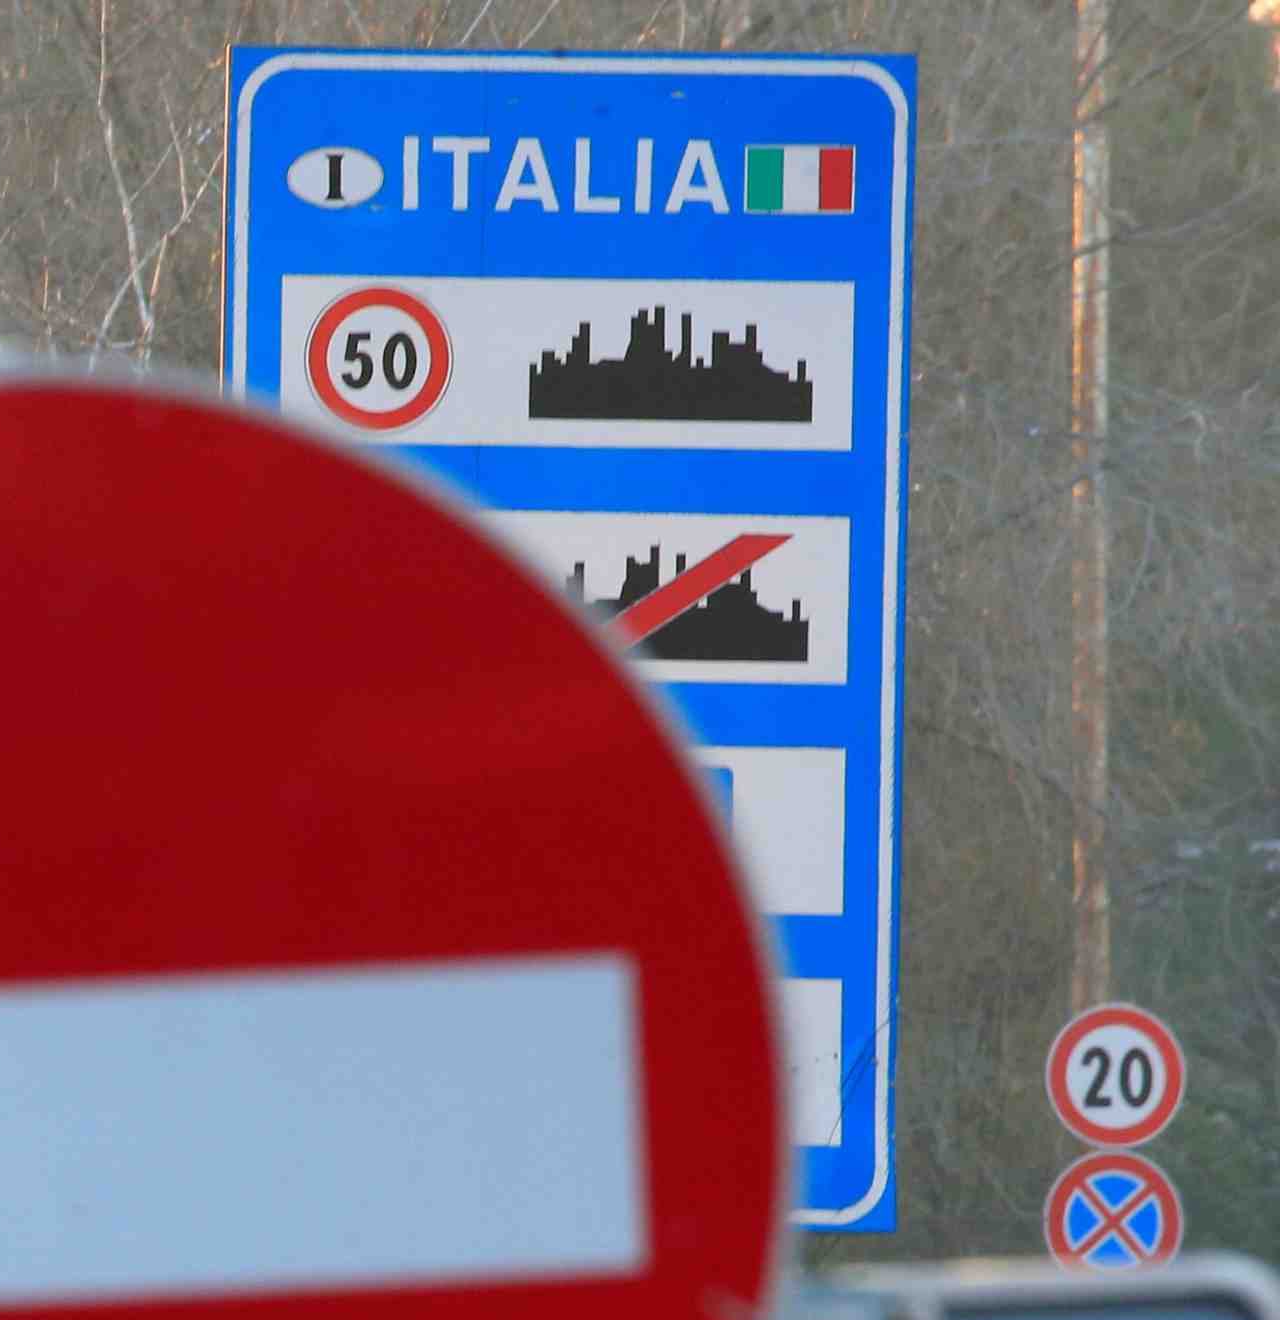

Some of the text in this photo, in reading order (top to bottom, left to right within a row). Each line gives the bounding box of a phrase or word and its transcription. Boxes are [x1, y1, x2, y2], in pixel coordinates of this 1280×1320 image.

[325, 136, 730, 214] I ITALIA
[341, 332, 417, 390] 50
[1081, 1046, 1152, 1108] 20
